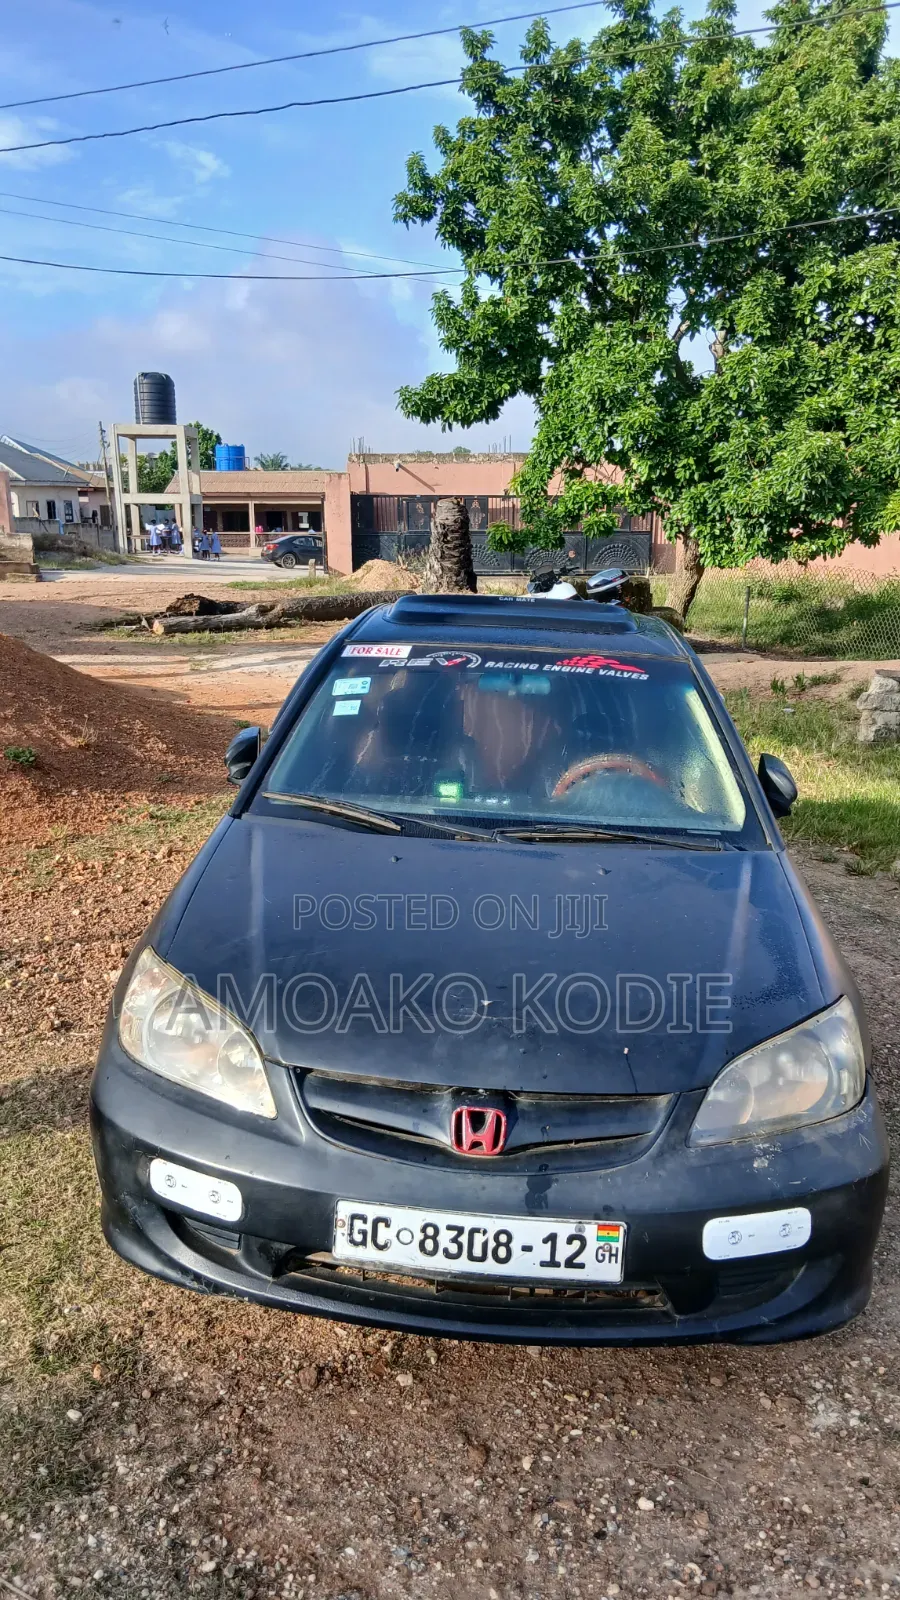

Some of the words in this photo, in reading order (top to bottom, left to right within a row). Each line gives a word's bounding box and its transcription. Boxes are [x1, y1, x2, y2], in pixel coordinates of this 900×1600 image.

[350, 647, 373, 655] FOR
[375, 647, 402, 656] SALE
[378, 656, 467, 668] REV
[484, 661, 539, 670] RACING
[542, 664, 595, 674] ENGINE
[598, 669, 649, 681] VALVES
[348, 1213, 391, 1251] GC
[595, 1245, 619, 1264] GH
